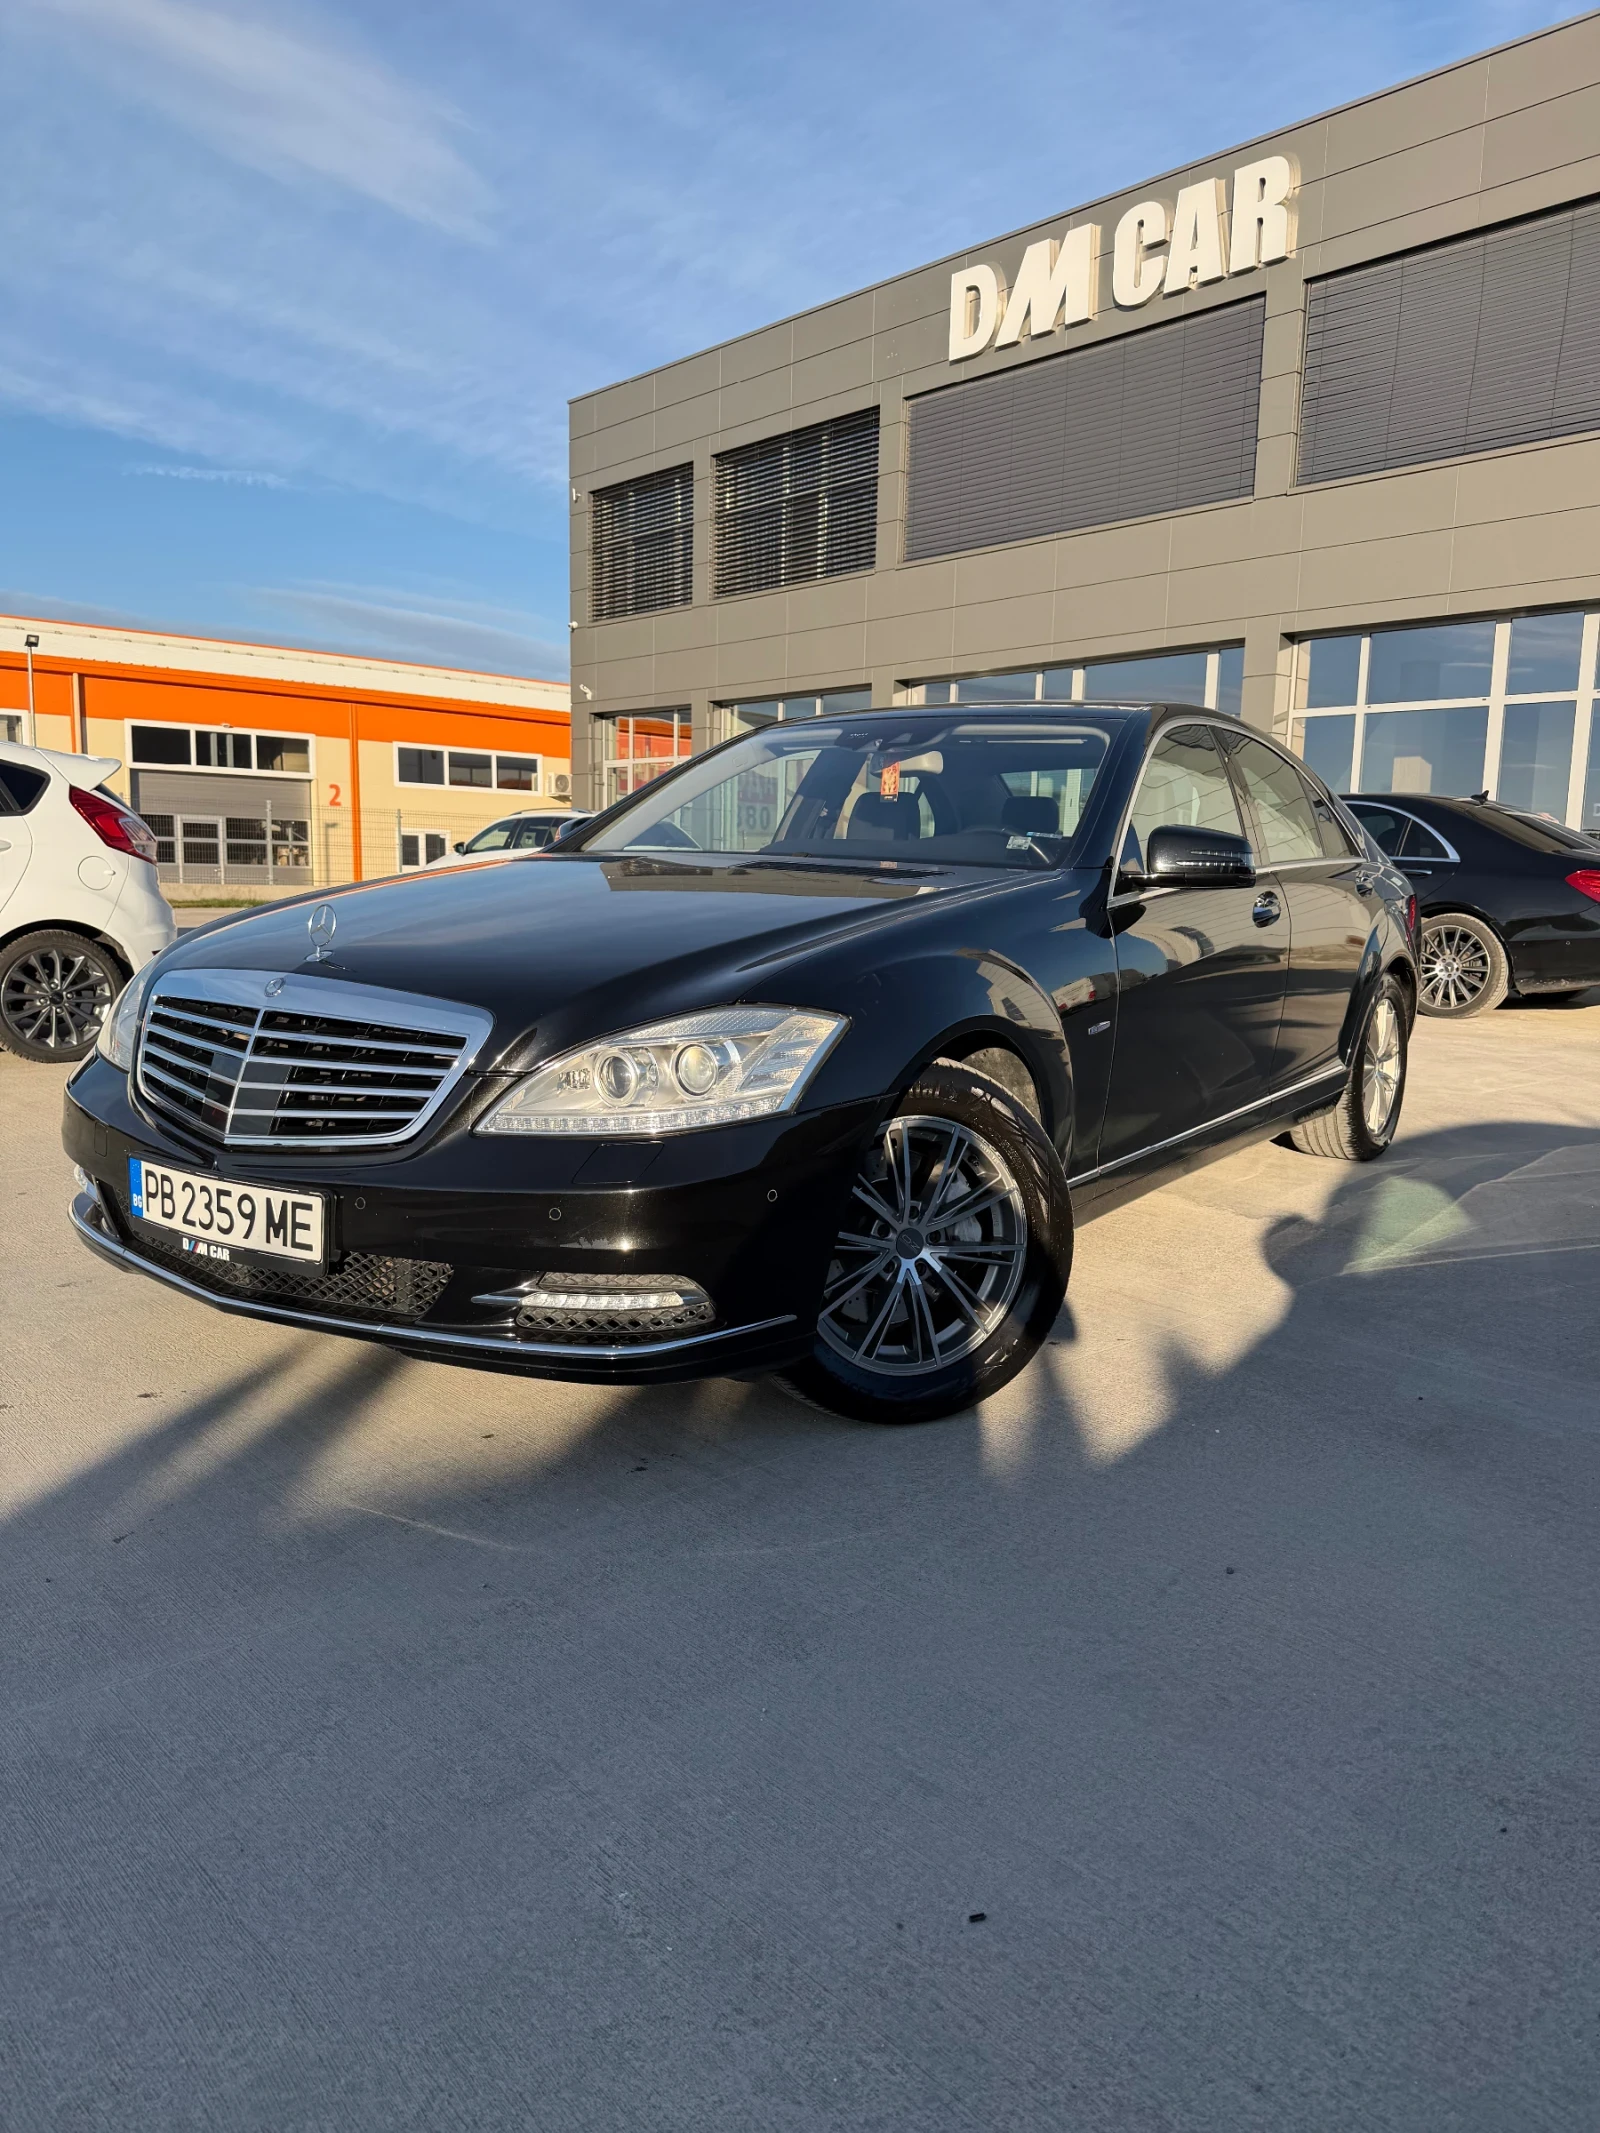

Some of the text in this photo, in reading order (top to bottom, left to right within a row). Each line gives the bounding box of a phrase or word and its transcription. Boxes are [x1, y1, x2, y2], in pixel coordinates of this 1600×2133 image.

[949, 154, 1298, 363] DM CAR
[329, 784, 341, 806] 2
[132, 1193, 143, 1208] BG
[209, 1245, 230, 1262] CAR
